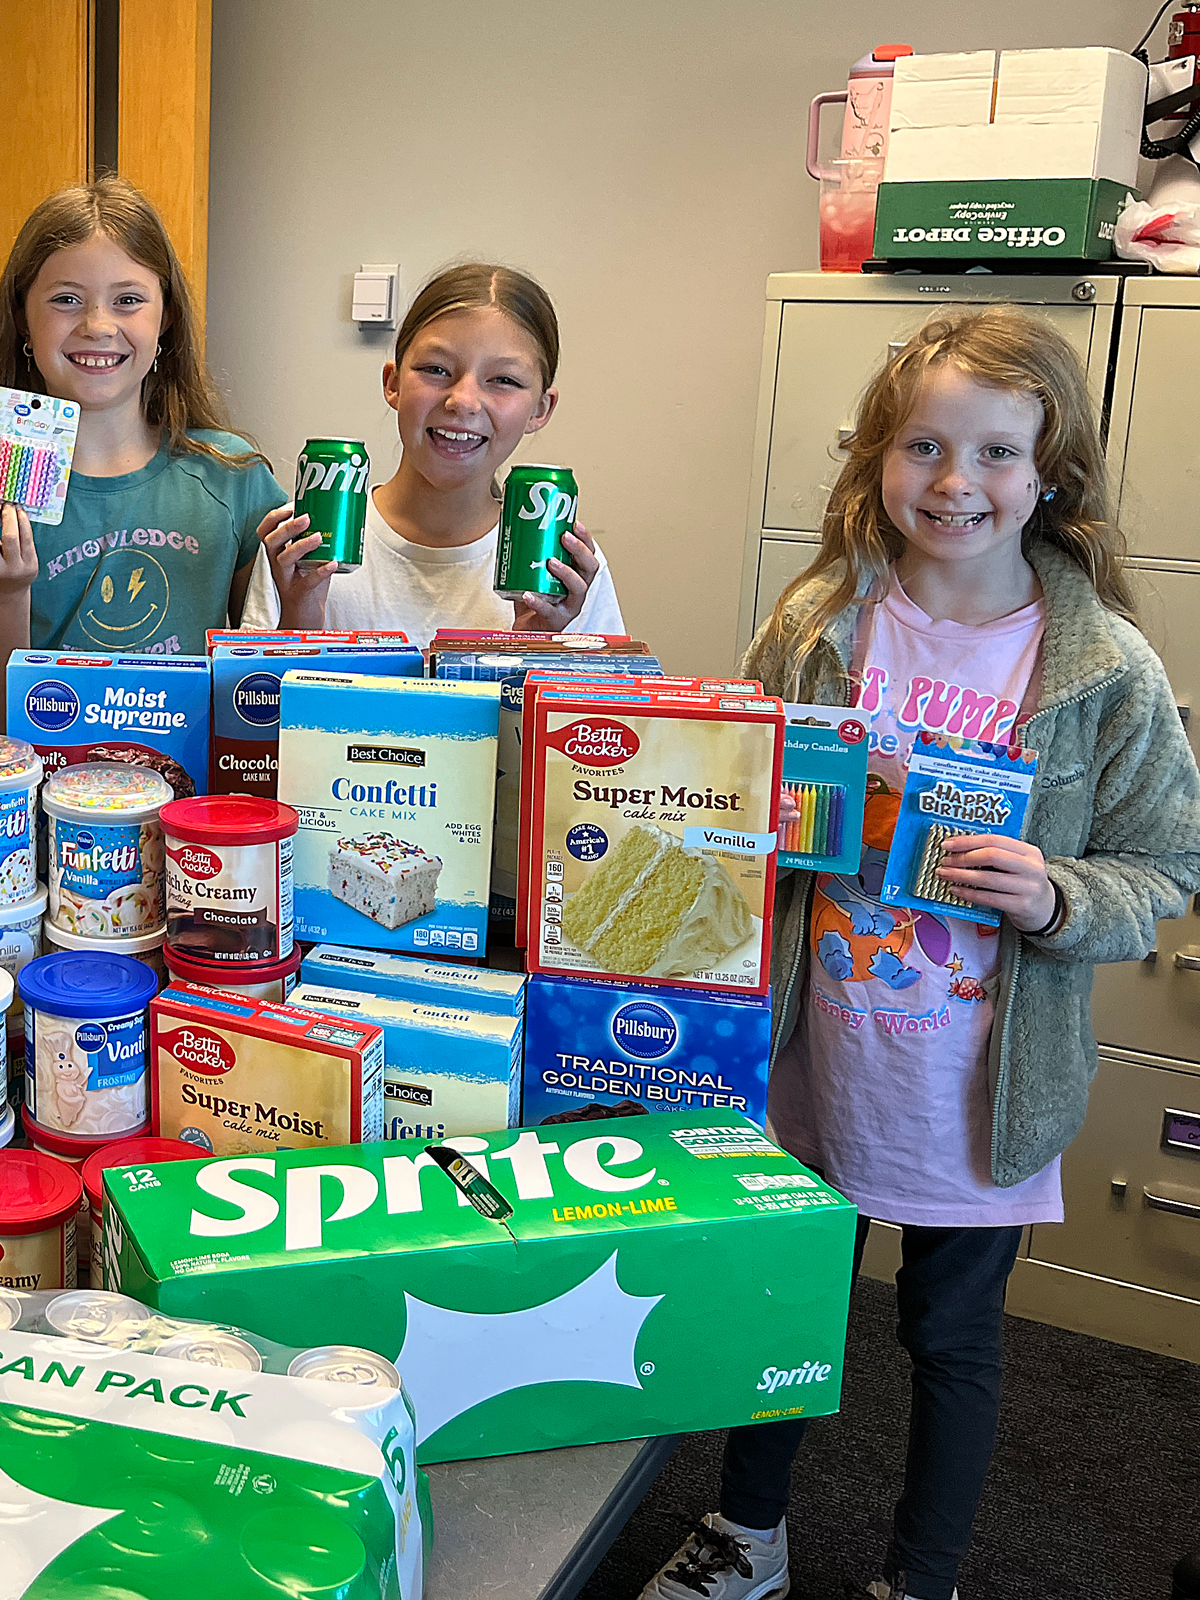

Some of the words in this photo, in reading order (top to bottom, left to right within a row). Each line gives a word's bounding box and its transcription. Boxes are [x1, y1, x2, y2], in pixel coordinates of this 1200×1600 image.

[954, 211, 1008, 221] EnviroCopy
[893, 227, 971, 243] DEPOT
[975, 226, 1066, 247] Office
[29, 696, 77, 717] Pillsbury
[104, 687, 168, 708] Moist
[84, 703, 185, 731] Supreme
[572, 724, 624, 746] Betty
[843, 725, 860, 736] 24
[351, 747, 377, 761] Best
[378, 749, 421, 765] Choice
[564, 741, 632, 759] Crocker
[243, 773, 257, 782] CAKE
[259, 773, 271, 782] MIX
[572, 764, 625, 777] FAVORITES
[331, 777, 437, 809] Confetti
[572, 780, 656, 810] Super
[660, 784, 740, 811] Moist
[934, 782, 1002, 810] HAPPY
[350, 807, 385, 819] CAKE
[392, 809, 417, 821] MIX
[921, 795, 1009, 824] BIRTHDAY
[445, 822, 462, 830] ADD
[465, 823, 482, 831] EGG
[451, 829, 482, 838] WHITES
[569, 836, 606, 846] America's
[581, 844, 595, 855] #1
[704, 830, 756, 850] Vanilla
[61, 841, 136, 873] Funfetti
[179, 857, 218, 875] Crocker
[182, 848, 212, 868] Betty
[548, 863, 562, 873] 160
[886, 884, 900, 895] 17
[203, 911, 258, 926] Chocolate
[423, 966, 479, 982] Confetti
[412, 1007, 470, 1023] Confetti
[815, 989, 867, 1030] isney
[873, 1006, 951, 1035] World
[77, 1031, 105, 1045] Pillsbury
[616, 1017, 674, 1045] Pillsbury
[177, 1030, 221, 1057] Betty
[173, 1044, 230, 1072] Crocker
[97, 1072, 136, 1088] FROSTING
[179, 1067, 224, 1087] FAVORITES
[556, 1053, 733, 1091] TRADITIONAL
[542, 1070, 640, 1098] GOLDEN
[647, 1085, 747, 1111] BUTTER
[181, 1084, 250, 1121] Super
[255, 1104, 325, 1139] Moist
[122, 1168, 156, 1187] 12
[128, 1179, 162, 1193] CANS
[188, 1131, 656, 1251] Sprite
[552, 1197, 678, 1224] LEMON-LIME
[756, 1360, 832, 1394] Sprite
[95, 1373, 254, 1419] PACK
[751, 1405, 805, 1420] LEMON-LIME
